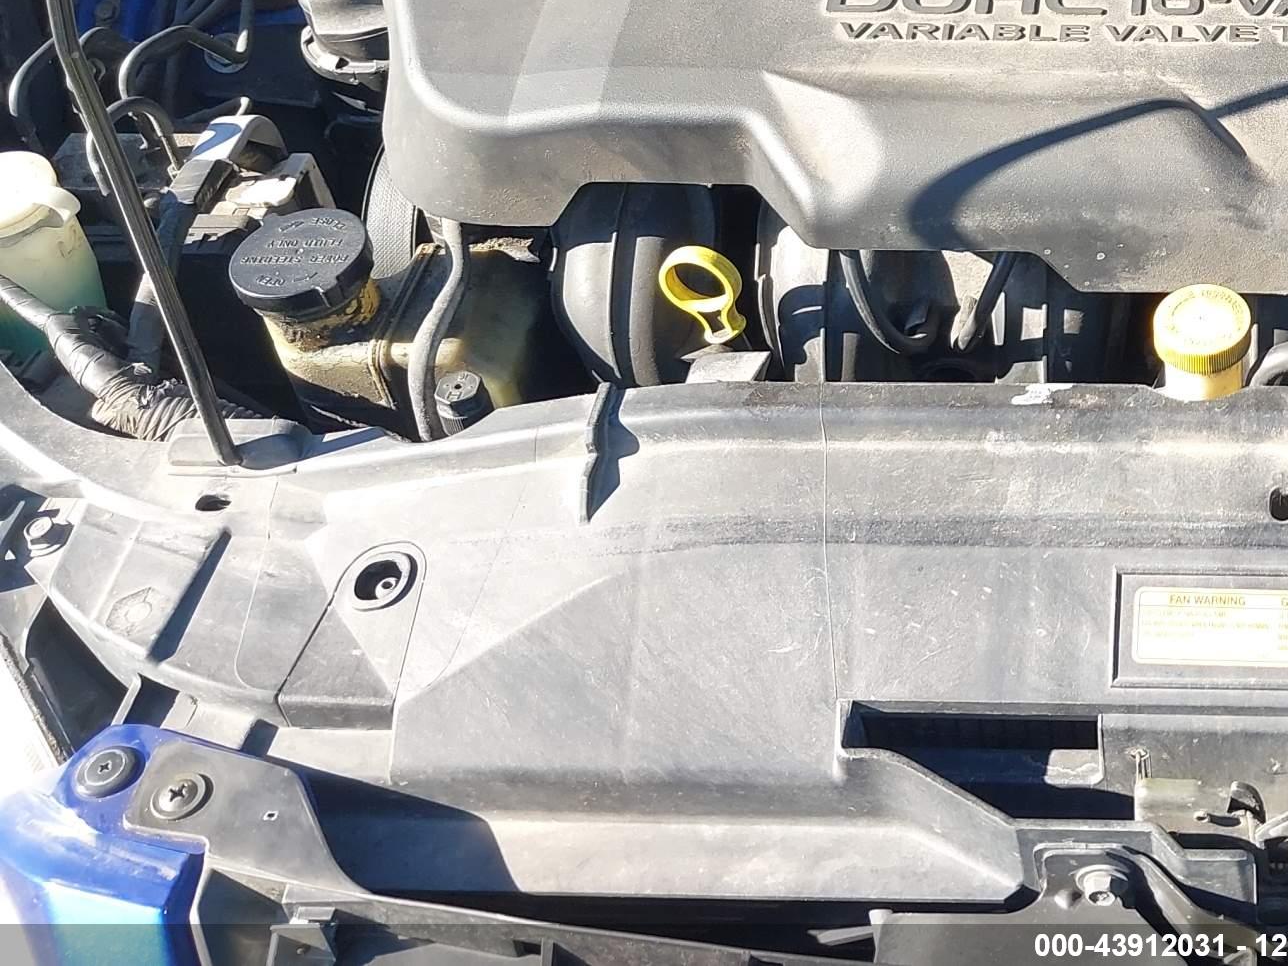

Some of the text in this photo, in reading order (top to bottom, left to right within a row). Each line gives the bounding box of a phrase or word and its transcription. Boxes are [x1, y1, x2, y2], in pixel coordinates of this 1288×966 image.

[840, 22, 1090, 42] VARIABLE
[1105, 24, 1259, 44] VALVE
[312, 217, 345, 230] CLOSE
[267, 238, 344, 248] FLUID ONLY
[240, 254, 349, 264] POWER STEERING
[256, 274, 286, 286] OPEN
[1169, 594, 1246, 606] FAN WARNING
